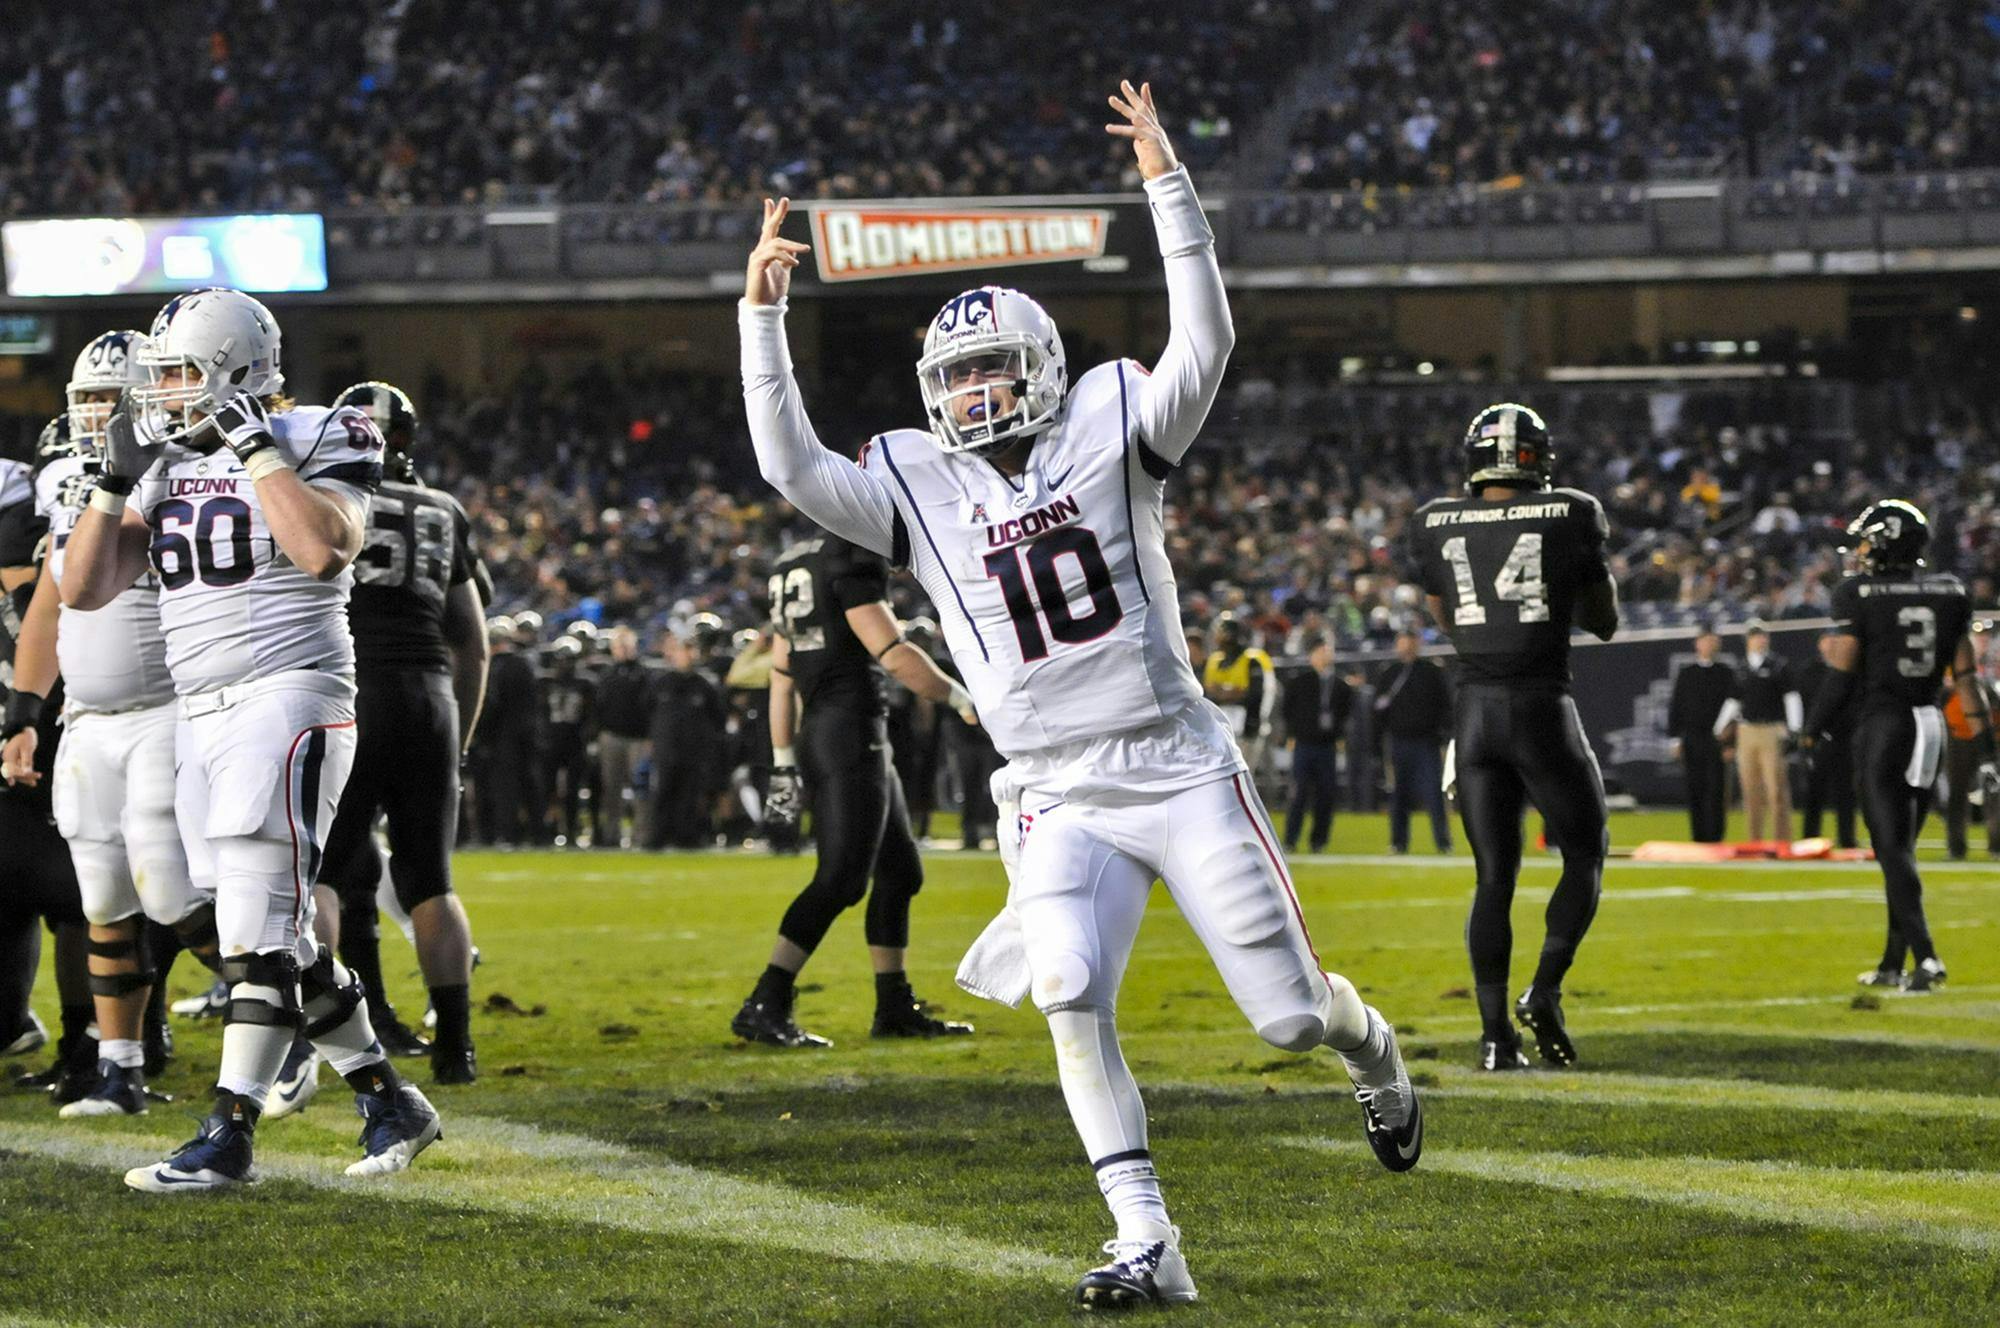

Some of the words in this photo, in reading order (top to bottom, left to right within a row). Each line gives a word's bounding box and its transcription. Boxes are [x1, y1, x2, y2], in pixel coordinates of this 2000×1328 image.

[825, 210, 1094, 271] ADMIRATION
[169, 479, 237, 497] UCONN
[986, 493, 1081, 548] UCONN
[150, 496, 255, 590] 60
[1441, 532, 1550, 626] 14
[982, 526, 1124, 664] 10
[1897, 606, 1937, 678] 3
